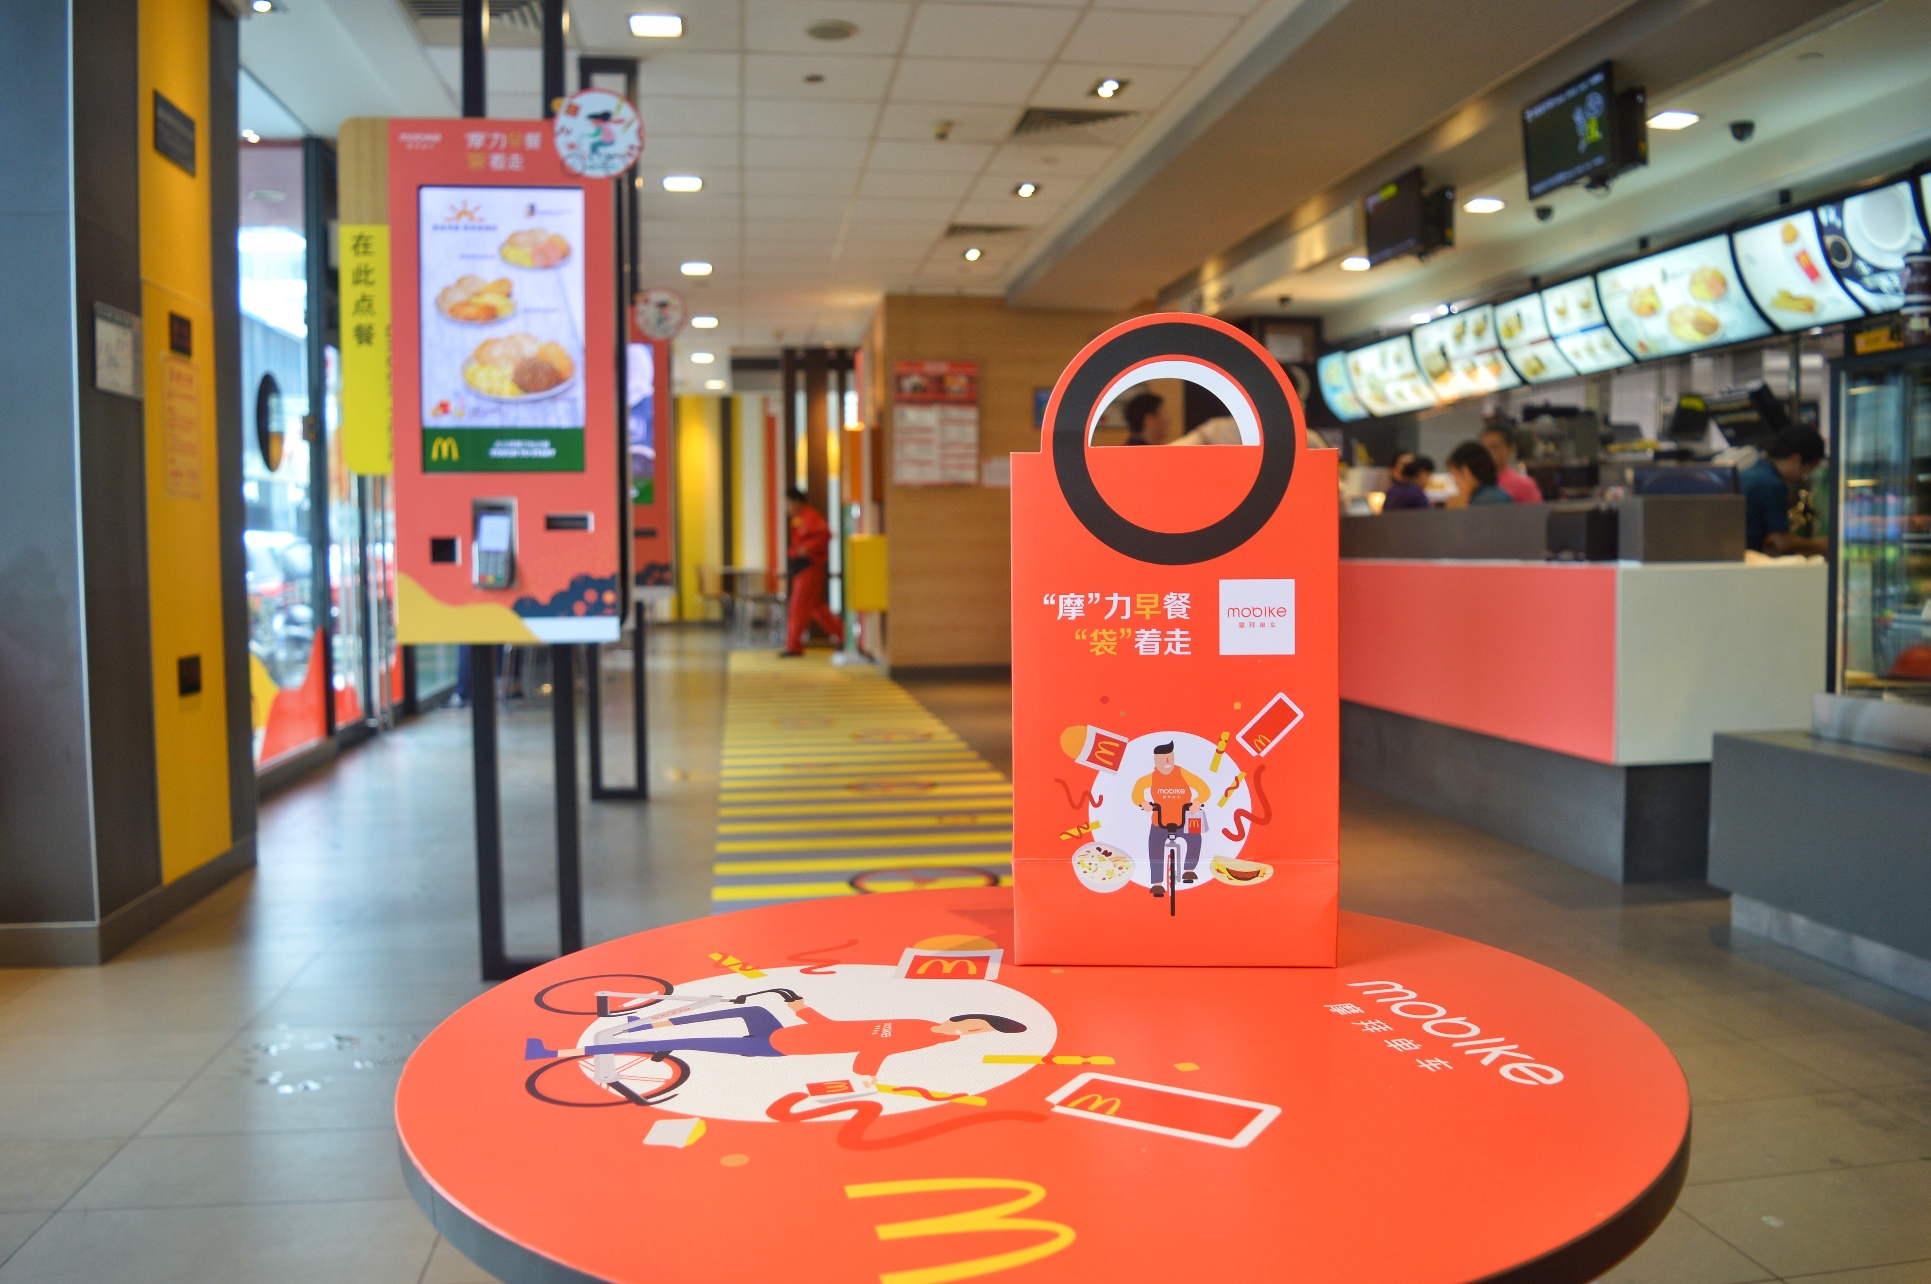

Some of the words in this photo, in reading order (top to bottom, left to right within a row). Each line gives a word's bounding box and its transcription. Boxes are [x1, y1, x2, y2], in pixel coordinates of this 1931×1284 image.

[351, 231, 375, 346] 在此点餐
[1227, 606, 1287, 618] mobike
[1323, 1002, 1454, 1072] 摩拜单车
[1346, 980, 1564, 1086] mobike
